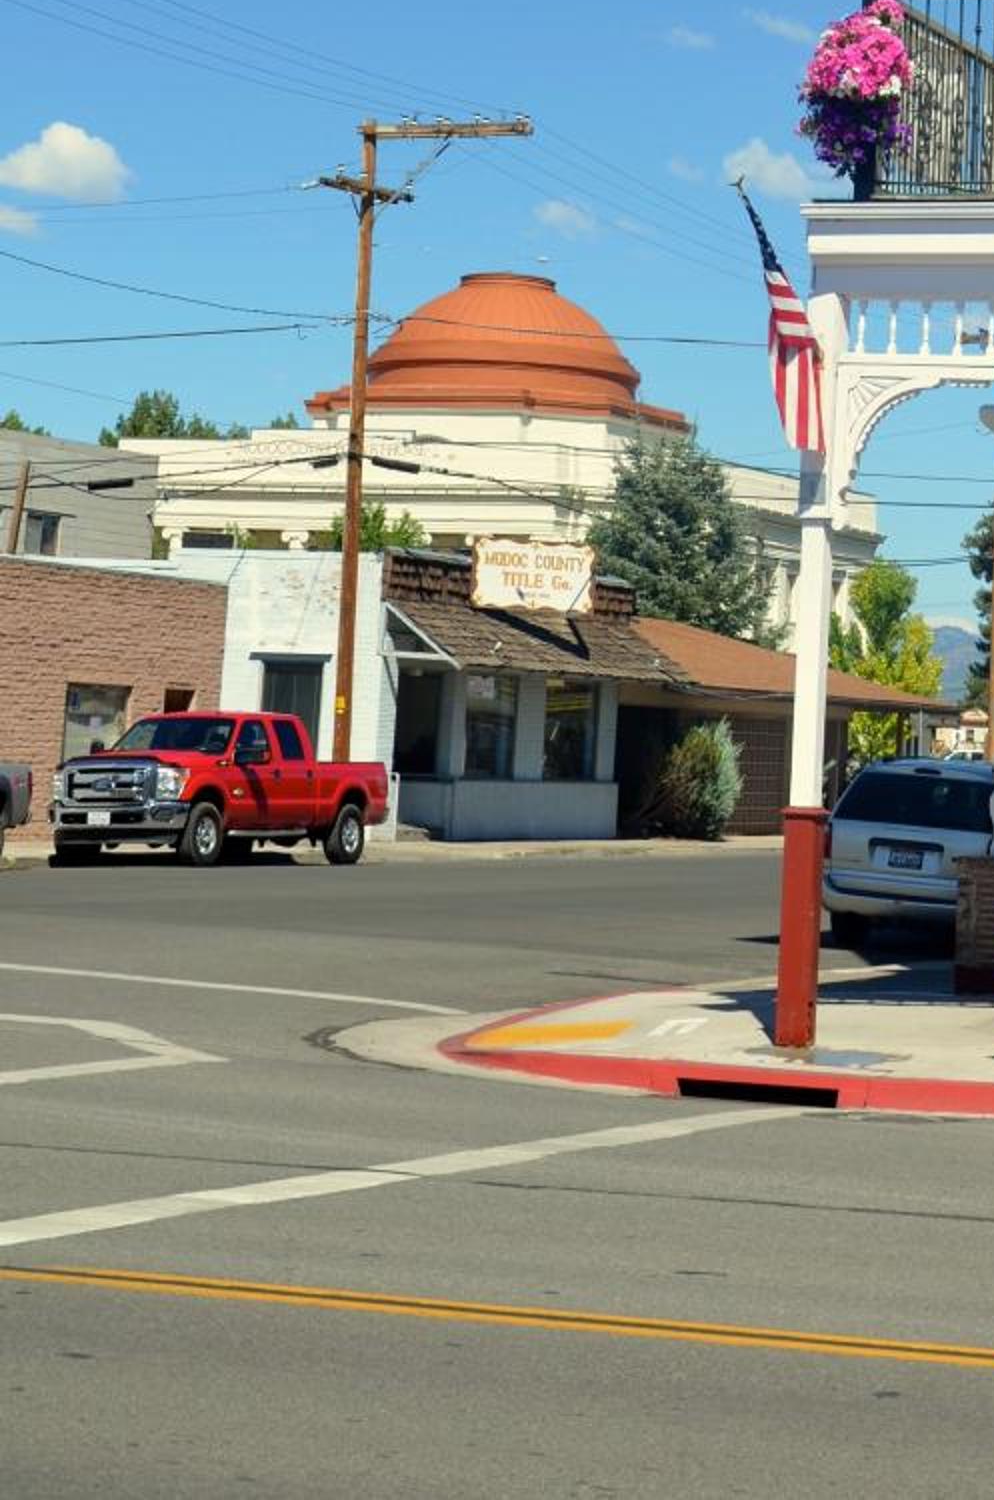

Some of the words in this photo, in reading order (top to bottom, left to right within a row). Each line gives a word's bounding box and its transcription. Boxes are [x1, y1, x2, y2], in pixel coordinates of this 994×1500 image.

[484, 551, 529, 569] MODOC
[536, 555, 585, 573] COUNTY
[502, 572, 544, 588] TITLE
